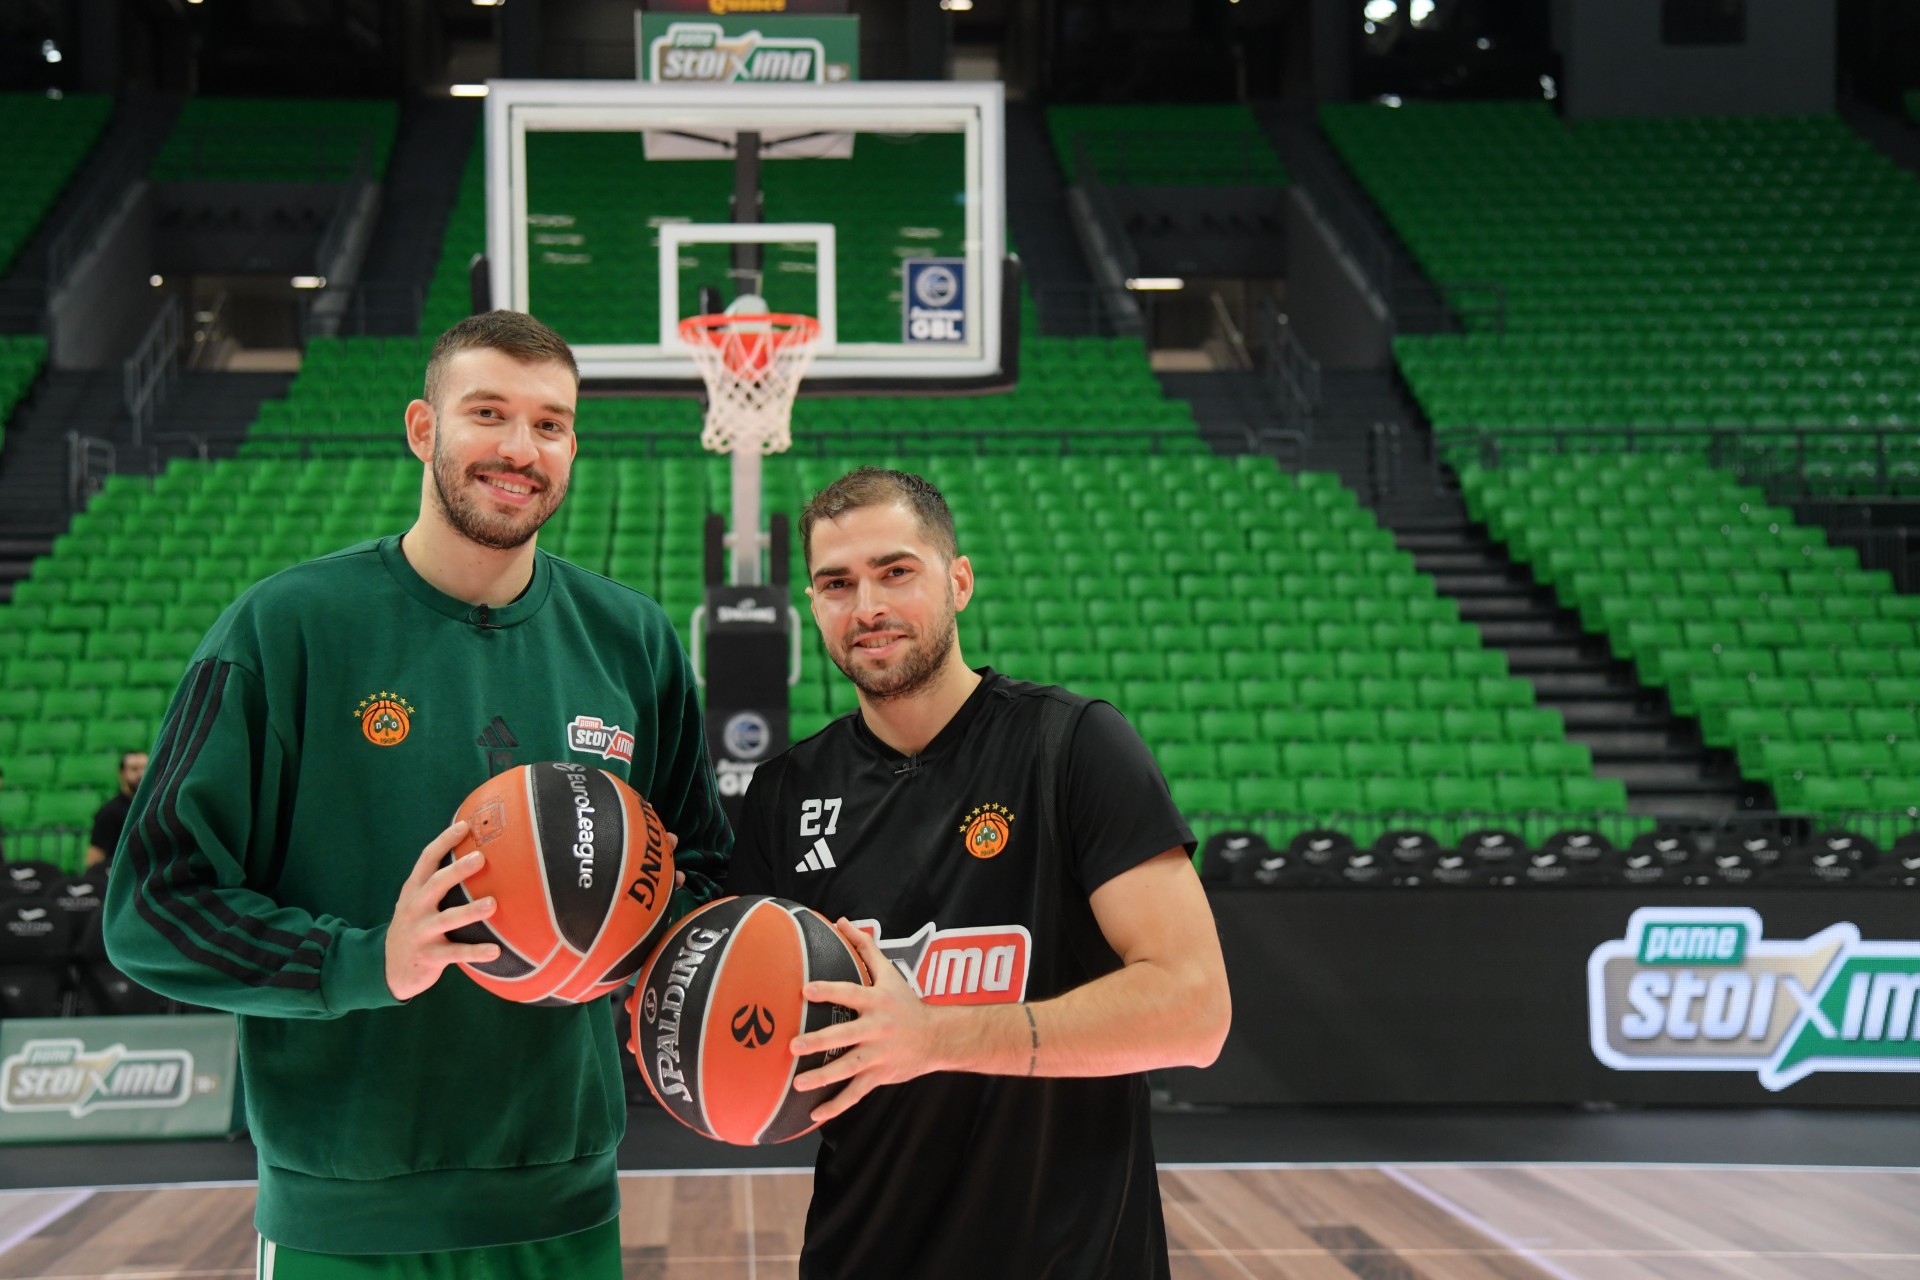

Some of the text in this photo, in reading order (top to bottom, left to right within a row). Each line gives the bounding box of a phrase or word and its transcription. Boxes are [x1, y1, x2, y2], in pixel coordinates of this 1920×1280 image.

[567, 773, 597, 890] EuroLeague
[800, 797, 843, 837] 27
[1645, 925, 1739, 963] pame
[657, 926, 724, 1103] SPALDING
